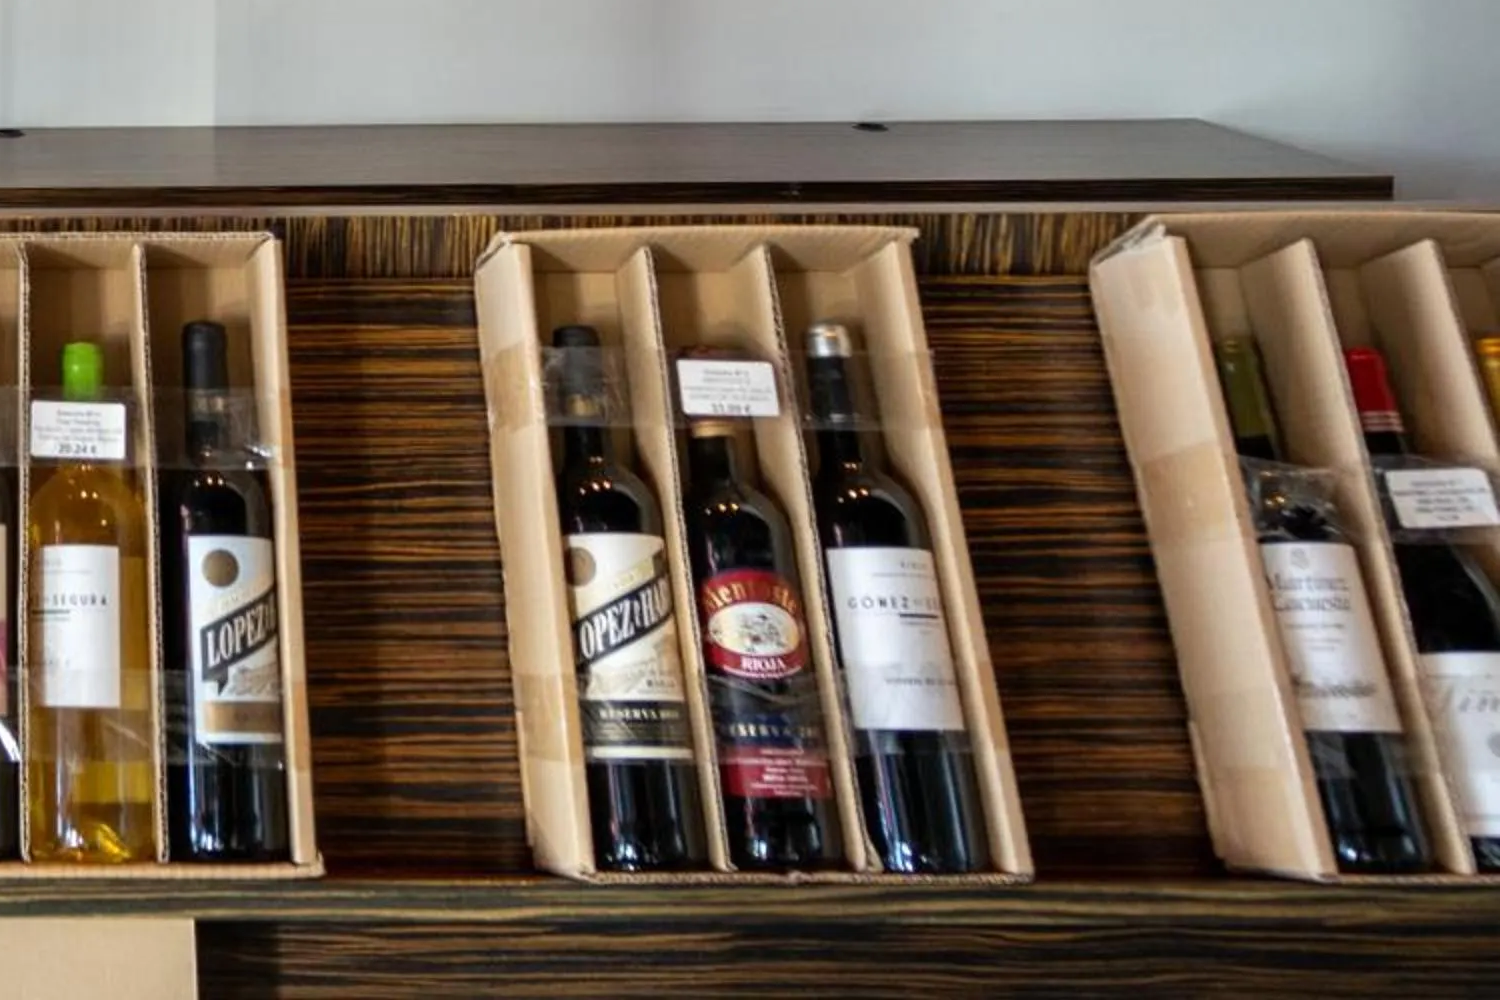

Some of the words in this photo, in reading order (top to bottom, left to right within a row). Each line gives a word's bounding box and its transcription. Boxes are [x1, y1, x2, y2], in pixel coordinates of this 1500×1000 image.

[206, 603, 266, 668] LOPEZ
[581, 598, 635, 660] OPEZ
[741, 656, 787, 673] RIOJA
